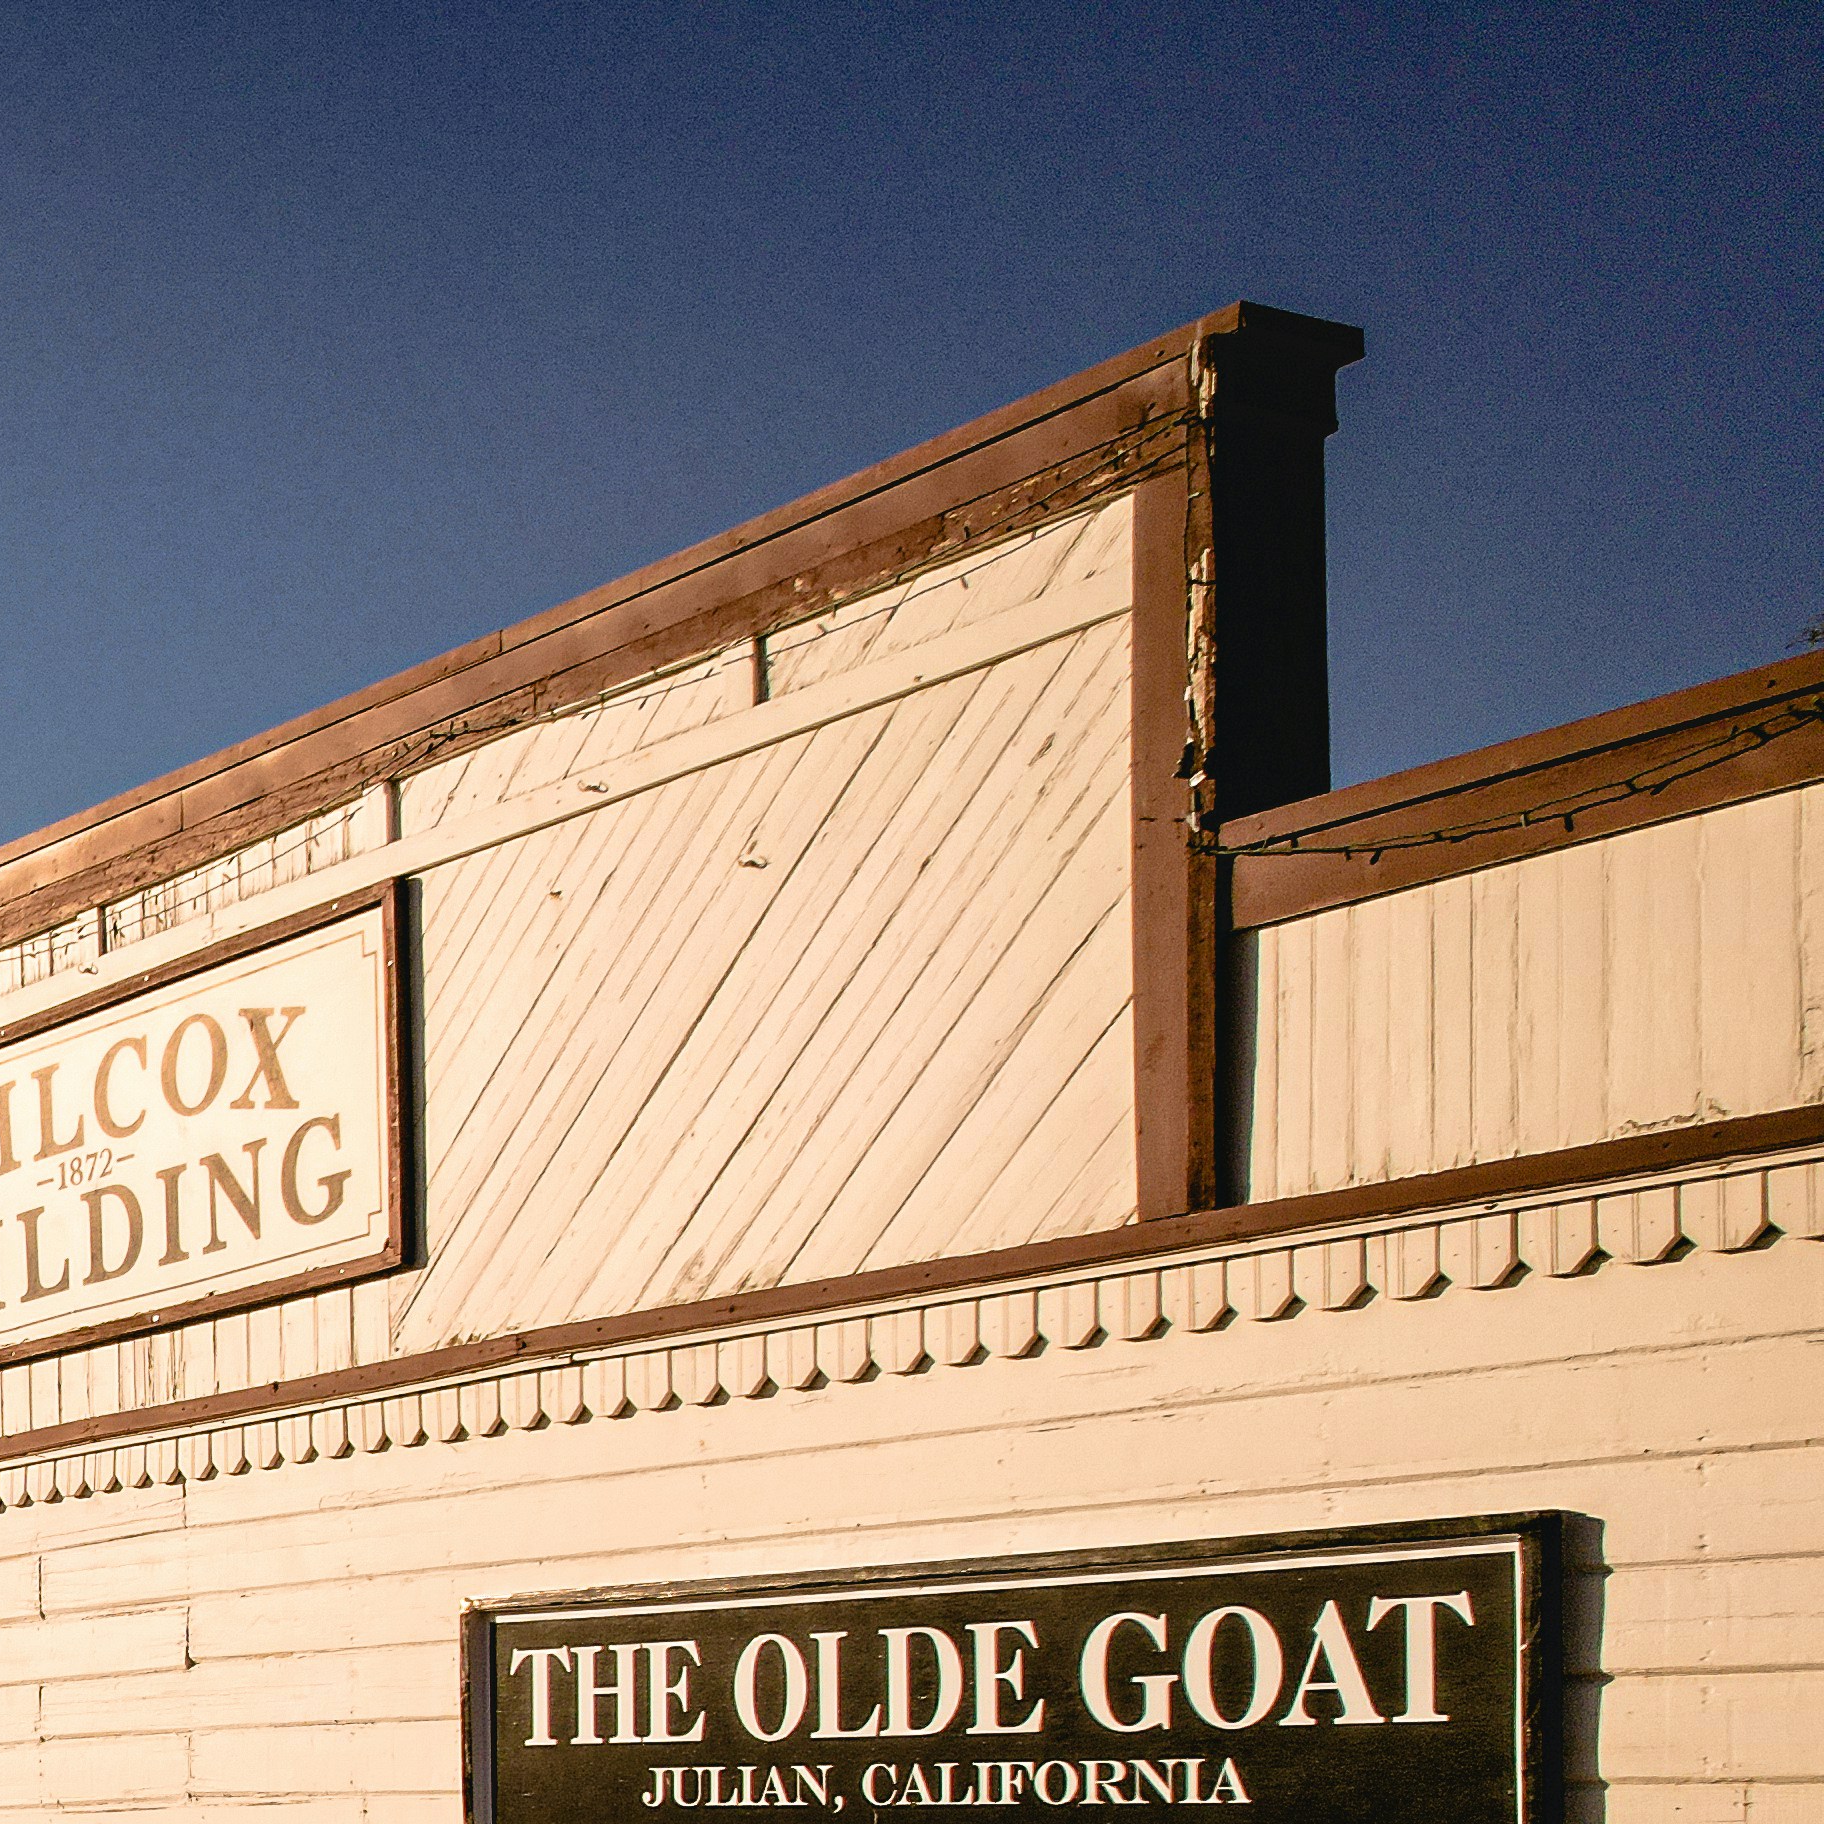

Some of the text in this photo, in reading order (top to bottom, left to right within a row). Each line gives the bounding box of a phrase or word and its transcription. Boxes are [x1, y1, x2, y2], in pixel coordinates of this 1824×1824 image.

[509, 1589, 1479, 1748] THE OLDE GOAT
[641, 1756, 1252, 1814] JULIAN, CALIFORNIA
